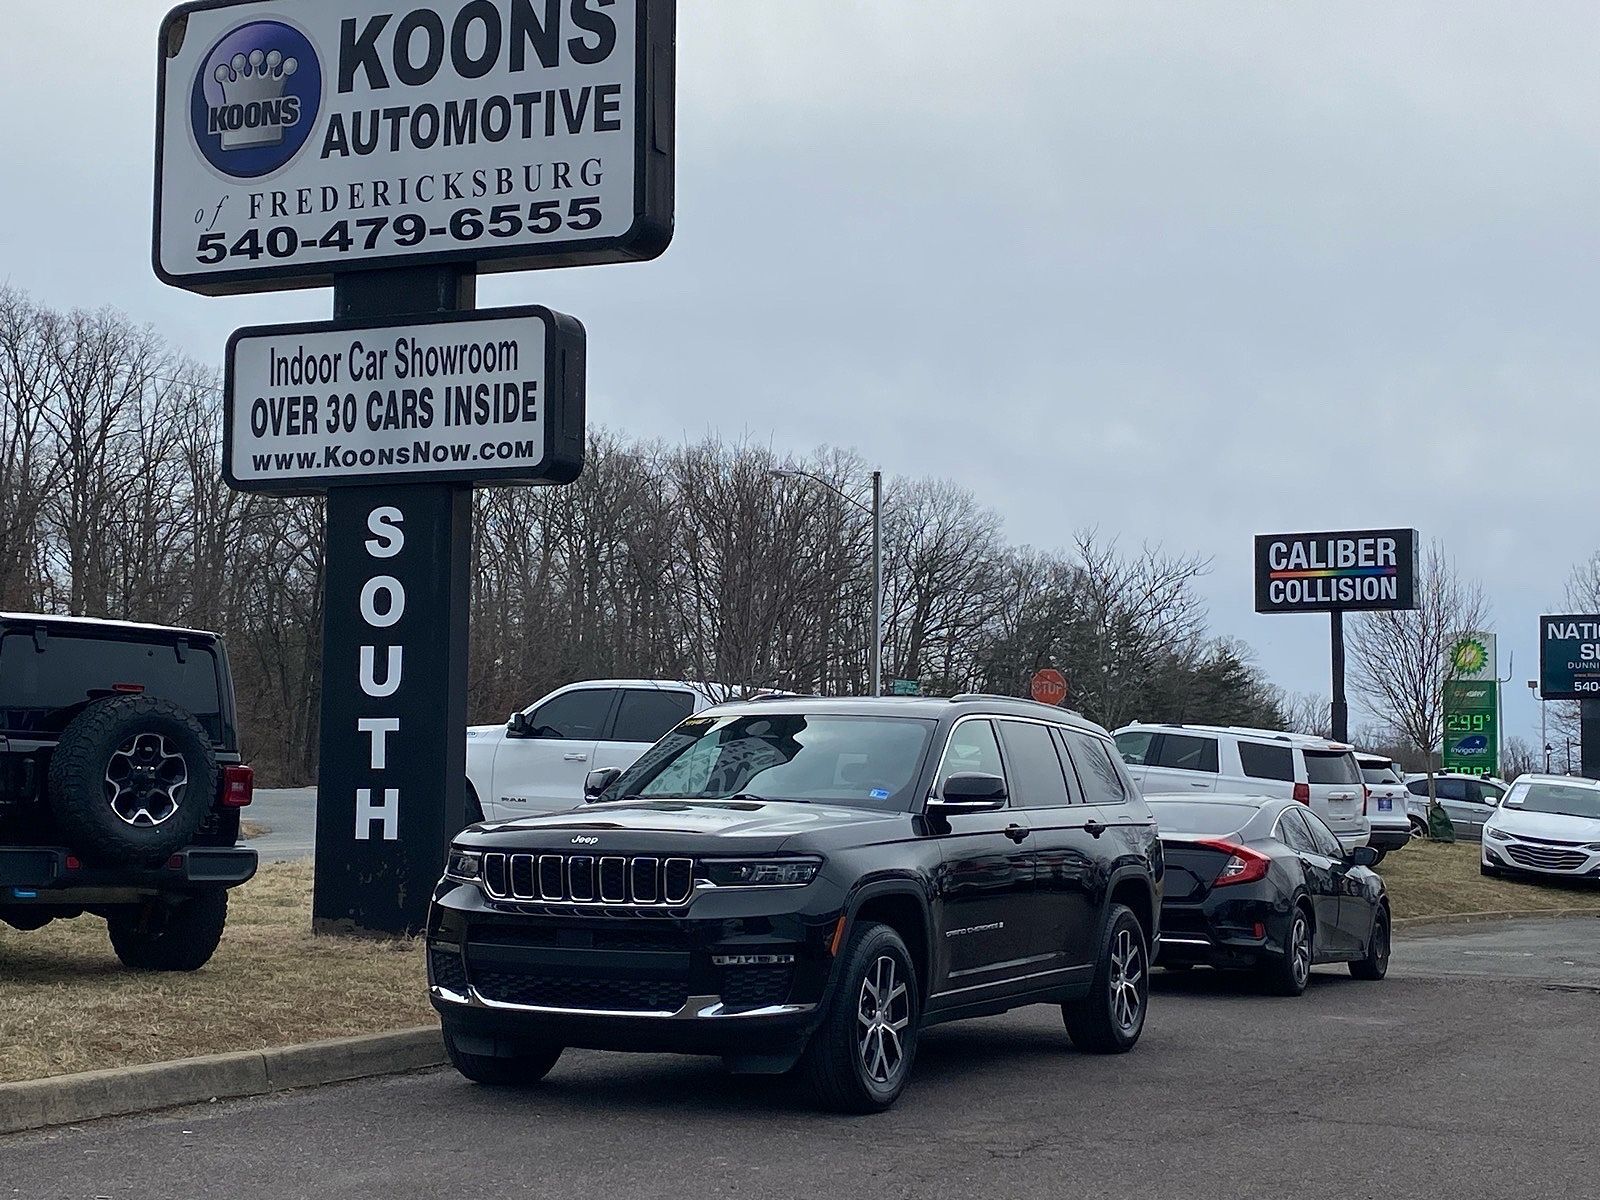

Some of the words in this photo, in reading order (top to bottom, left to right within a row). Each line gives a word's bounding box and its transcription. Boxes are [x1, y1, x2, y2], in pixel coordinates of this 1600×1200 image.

[337, 0, 617, 93] KOONS
[208, 96, 300, 134] KOONS
[320, 83, 622, 160] AUTOMOTIVE
[192, 195, 230, 231] of
[248, 157, 604, 220] FREDERICKSBURG
[195, 196, 603, 264] 540-479-6555
[270, 346, 341, 387] Indoor
[348, 340, 388, 382] Car
[394, 337, 519, 379] Showroom
[250, 394, 319, 438] OVER
[326, 392, 357, 435] 30
[365, 387, 434, 432] CARS
[444, 380, 538, 427] INSIDE
[1269, 537, 1397, 571] CALIBER
[1269, 576, 1397, 604] COLLISION
[1547, 622, 1600, 640] NATI
[355, 506, 406, 840] SOUTH
[571, 834, 599, 845] Jeep
